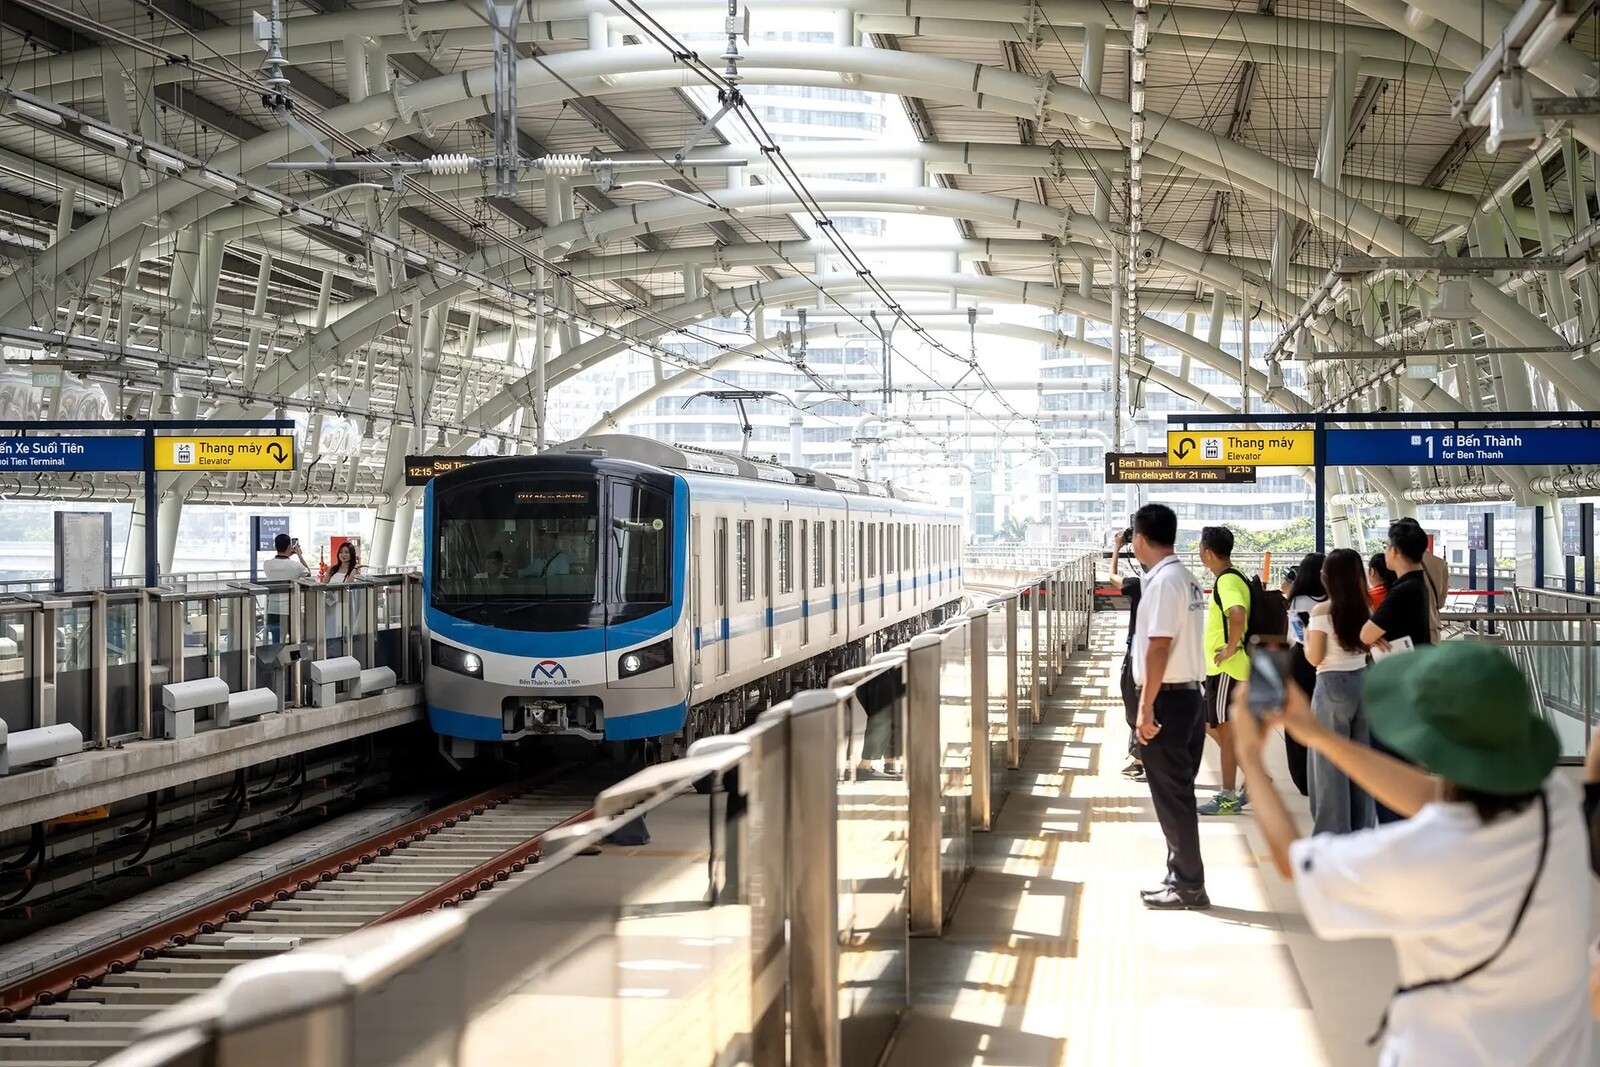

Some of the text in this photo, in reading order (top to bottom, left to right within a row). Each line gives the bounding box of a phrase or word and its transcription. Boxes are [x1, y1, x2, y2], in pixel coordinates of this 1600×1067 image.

[1228, 436, 1294, 450] Thang máy
[1442, 434, 1522, 446] đi Bến Thành
[15, 442, 30, 454] Xe
[32, 442, 58, 454] Suối
[60, 442, 84, 454] Tiên
[199, 442, 262, 455] Thang máy
[1425, 436, 1434, 458] 1
[1227, 452, 1262, 460] Elevator
[1442, 450, 1504, 458] for Ben Thanh
[10, 458, 28, 466] Tien
[29, 458, 65, 466] Terminal
[434, 462, 452, 470] Suoi
[409, 468, 432, 476] 12:15
[1109, 462, 1116, 475] 1
[1120, 471, 1218, 480] Train delayed for 21 min.
